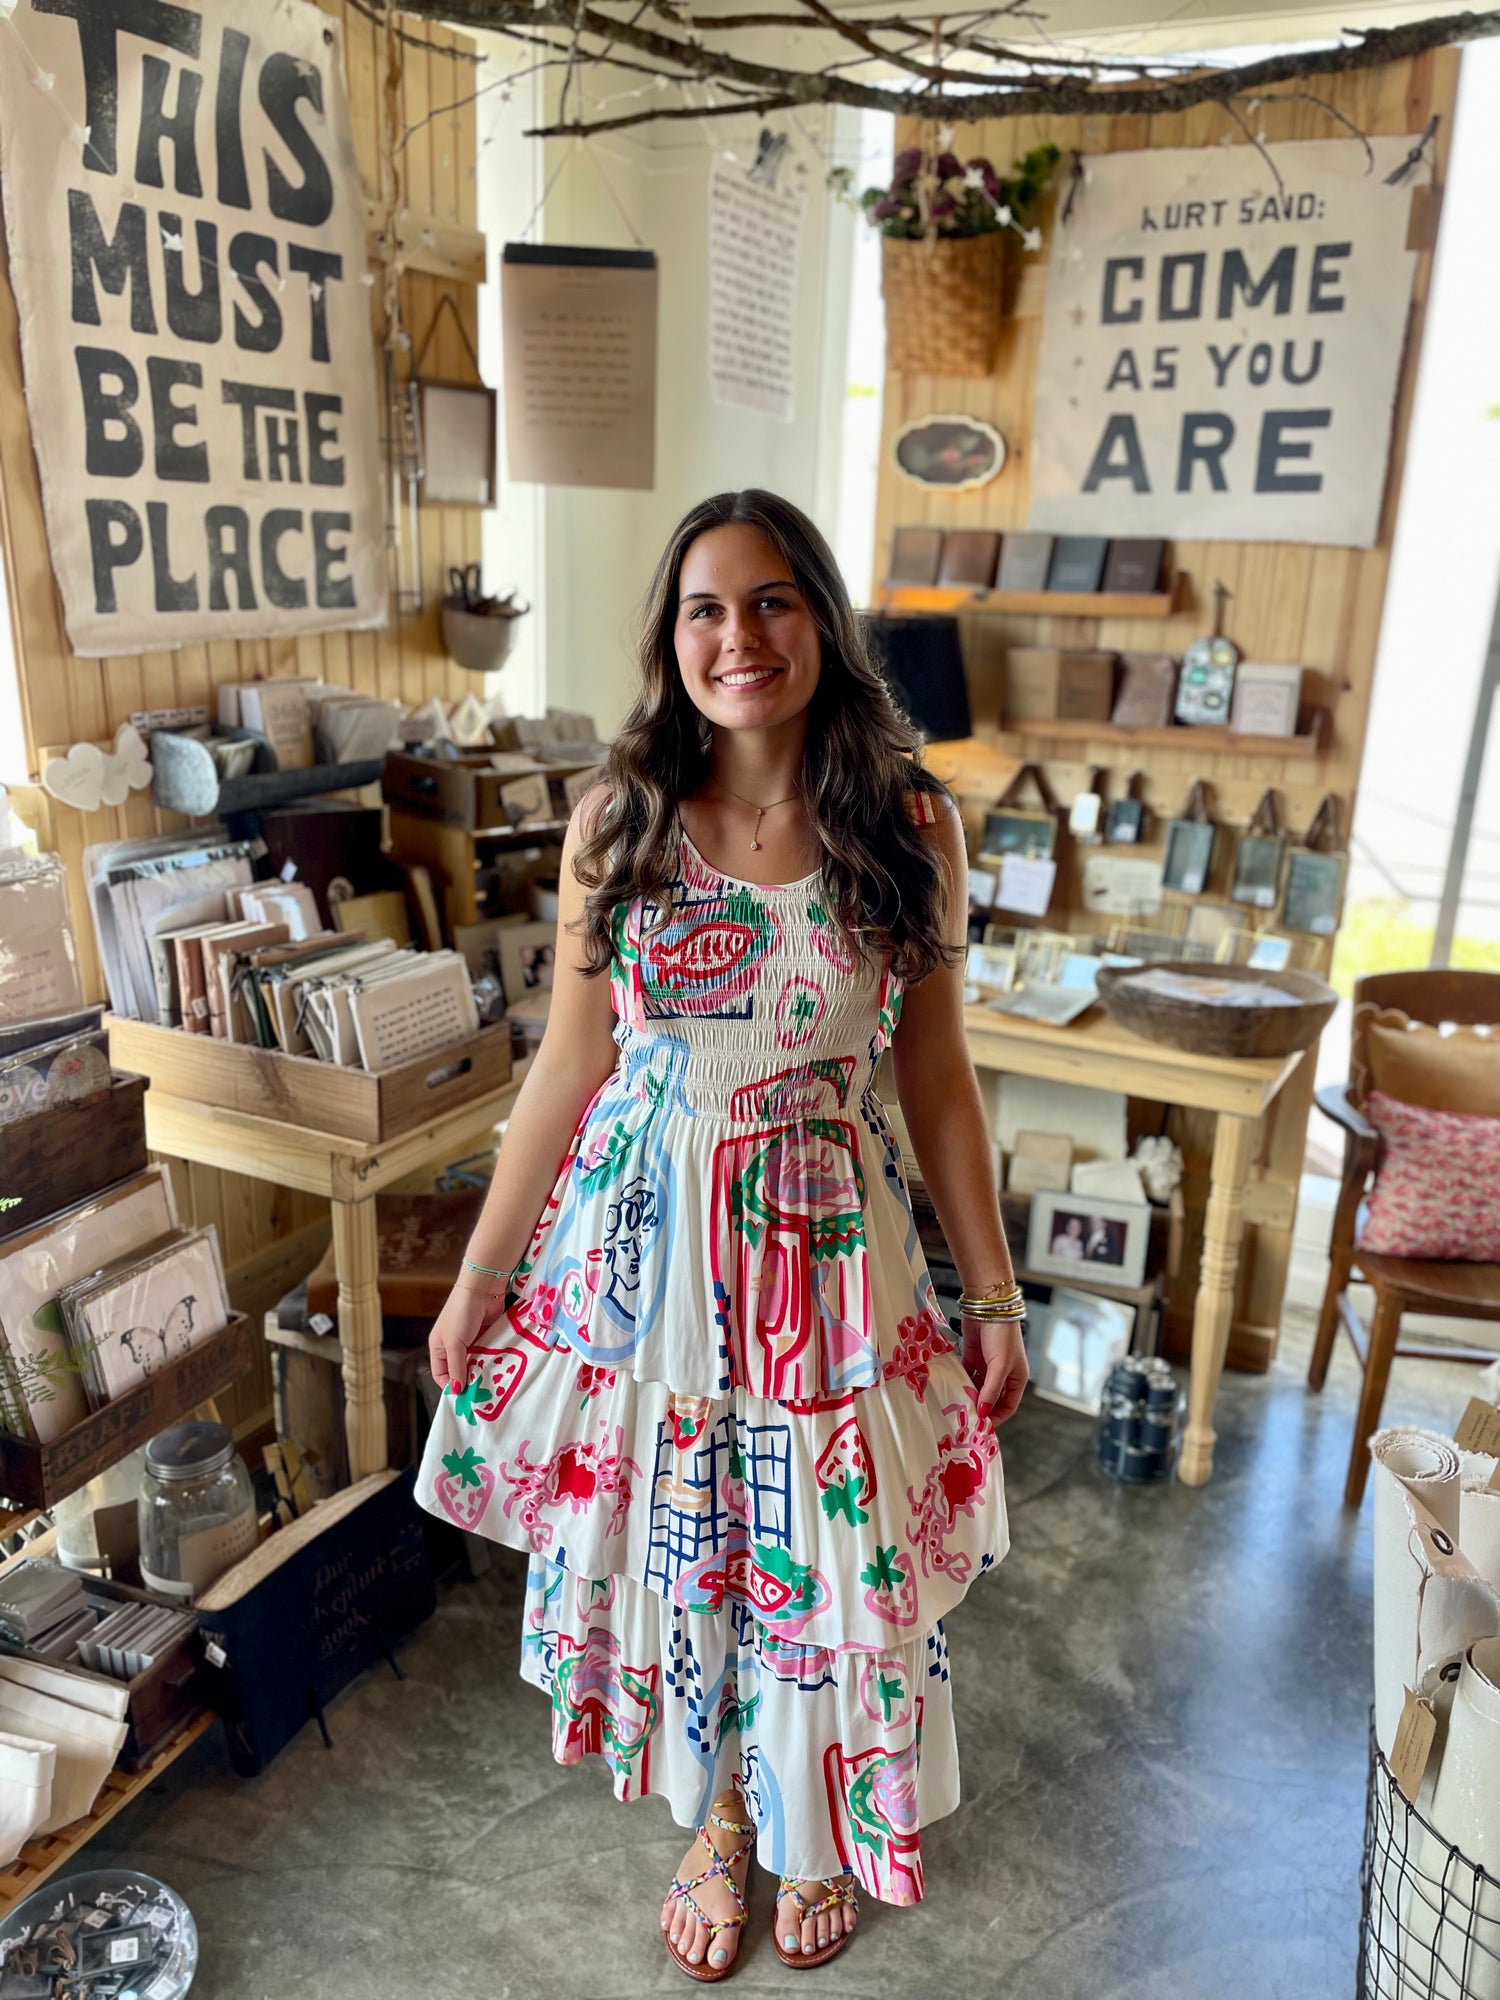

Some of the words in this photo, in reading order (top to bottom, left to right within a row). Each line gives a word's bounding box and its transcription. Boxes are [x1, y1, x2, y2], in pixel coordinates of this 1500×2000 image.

[31, 0, 336, 227] THIS
[1141, 201, 1228, 231] KURT
[1239, 193, 1326, 225] SAID:
[68, 188, 343, 363] MUST
[1101, 242, 1353, 325] COME
[1105, 347, 1178, 391] AS
[1206, 340, 1324, 388] YOU
[75, 346, 210, 484] BE
[222, 380, 346, 487] THE
[1080, 408, 1333, 494] ARE
[85, 498, 358, 615] PLACE
